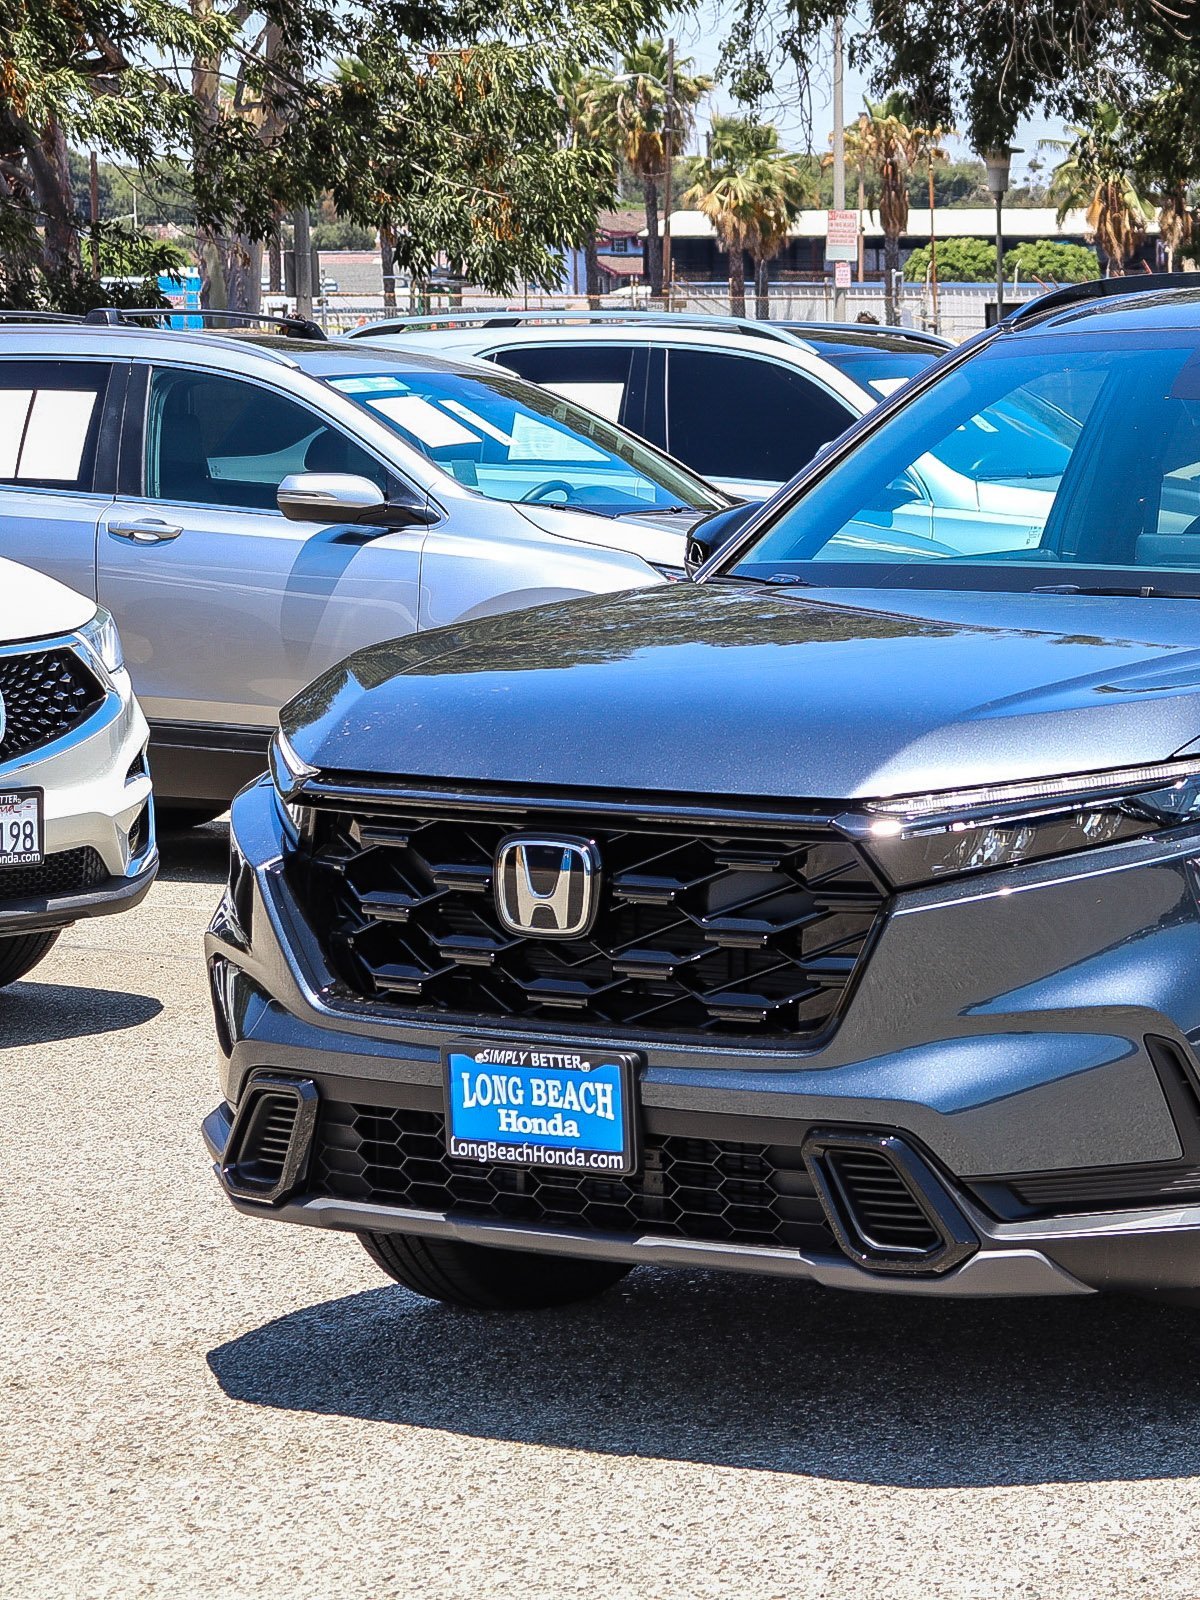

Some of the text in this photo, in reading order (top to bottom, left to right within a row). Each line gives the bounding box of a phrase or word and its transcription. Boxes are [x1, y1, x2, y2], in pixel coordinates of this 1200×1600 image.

[483, 1048, 582, 1069] SIMPLY BETTER
[461, 1072, 615, 1121] LONG BEACH
[498, 1108, 580, 1138] Honda
[450, 1135, 624, 1170] LongBeachHonda.com
